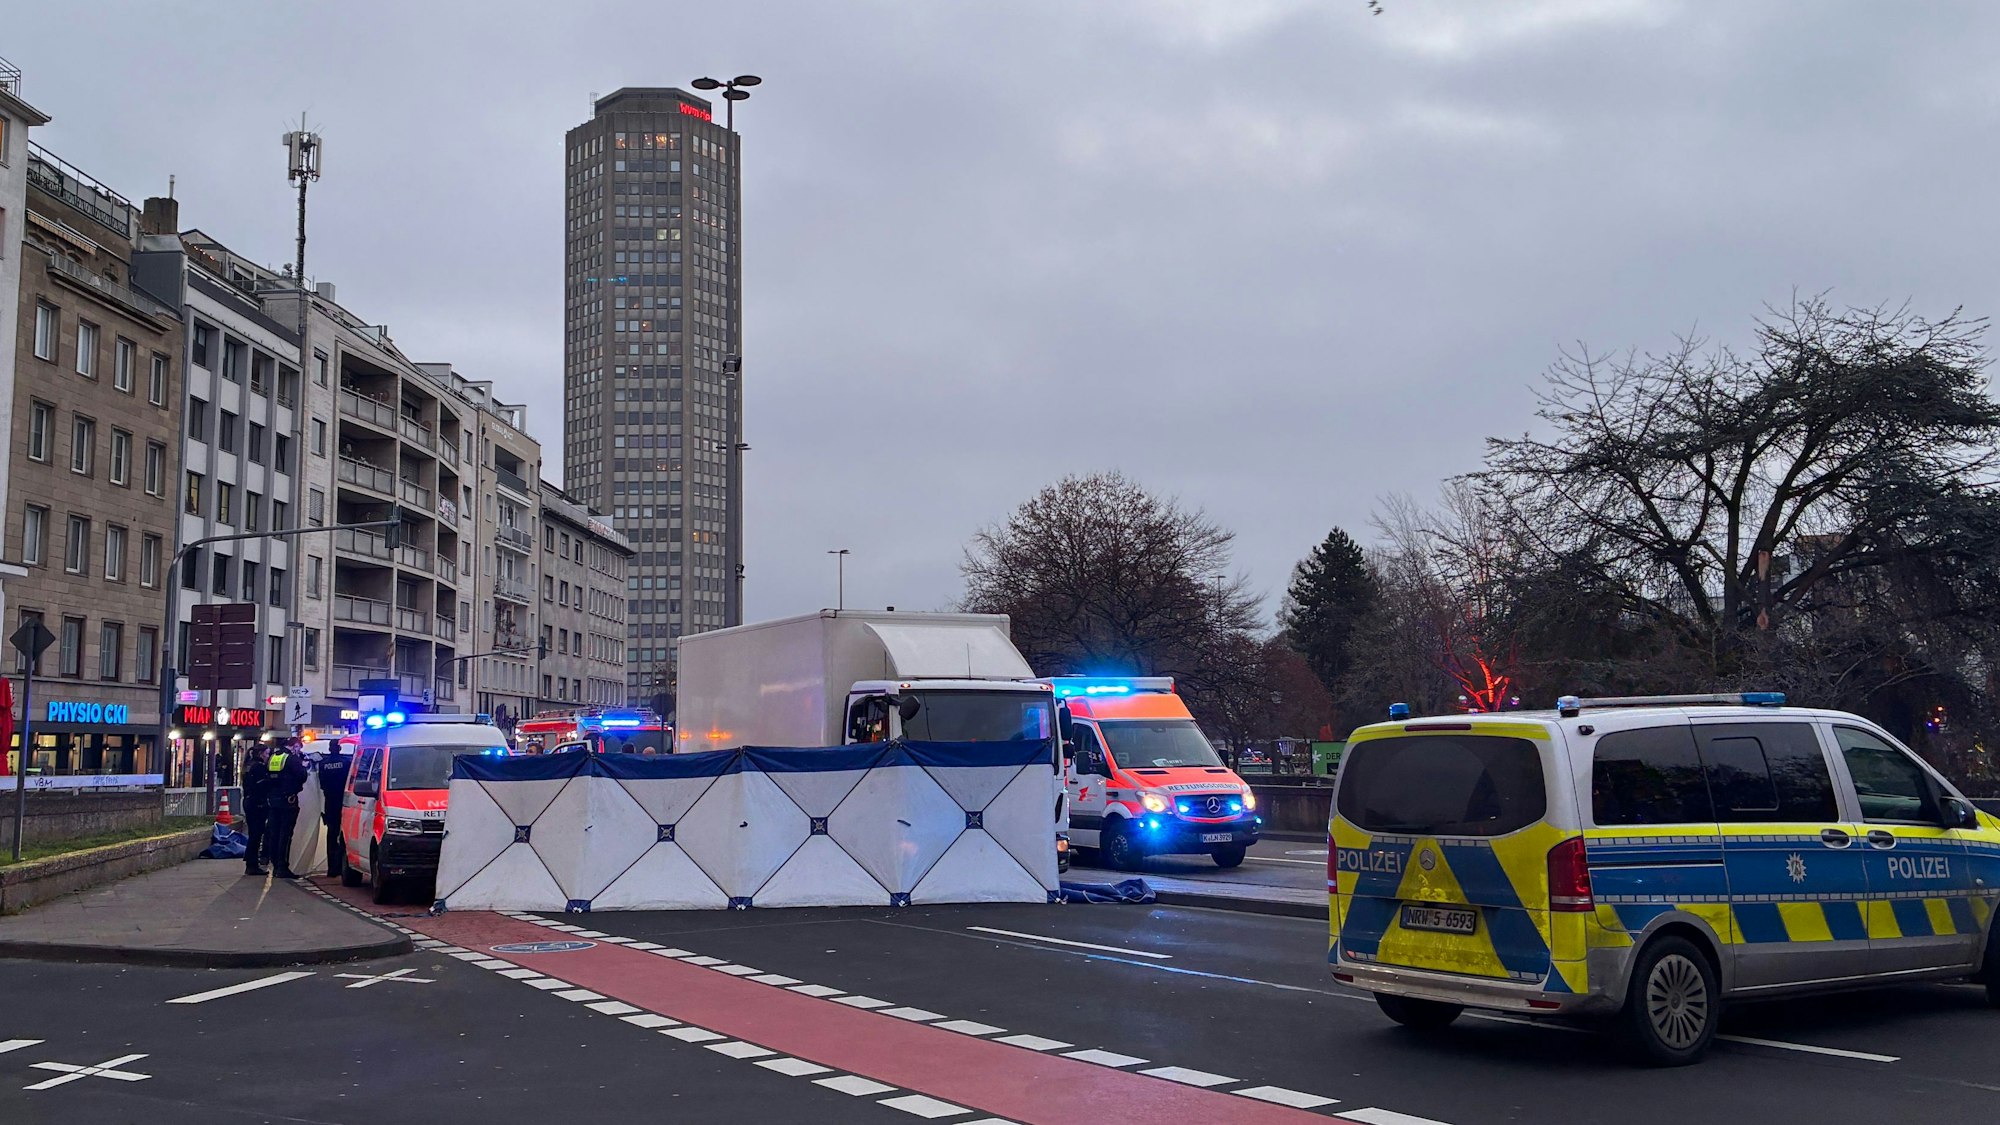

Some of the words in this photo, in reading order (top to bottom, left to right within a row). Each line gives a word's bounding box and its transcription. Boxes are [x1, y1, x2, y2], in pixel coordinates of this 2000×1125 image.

[48, 701, 102, 723] PHYSIO
[104, 703, 127, 724] CKI
[230, 708, 260, 726] KIOSK
[1168, 783, 1240, 791] RETTUNGSDIENST
[1338, 849, 1401, 873] POLIZEI
[1888, 856, 1951, 878] POLIZEI
[1407, 908, 1428, 925] NRW
